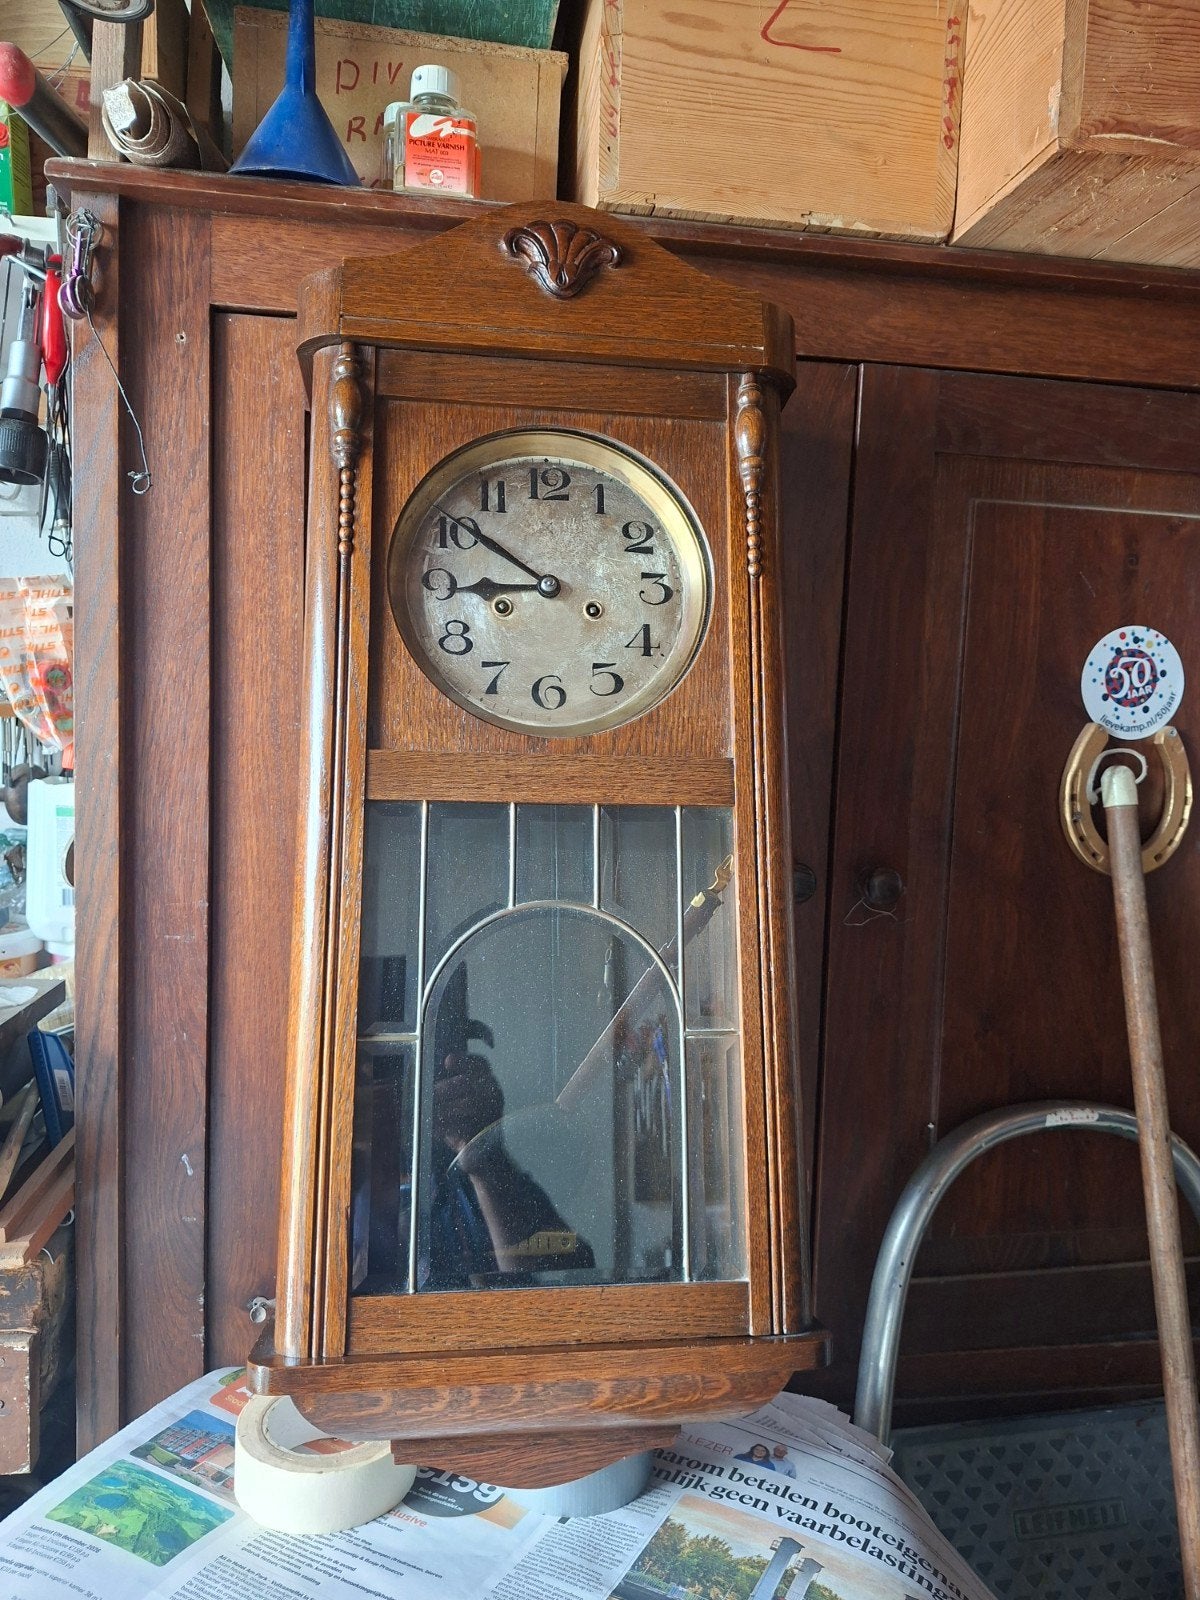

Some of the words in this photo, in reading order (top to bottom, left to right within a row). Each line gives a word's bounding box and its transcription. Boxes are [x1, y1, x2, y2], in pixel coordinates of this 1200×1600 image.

[409, 138, 435, 147] PICTURE
[437, 142, 465, 150] VARNISH
[480, 480, 506, 513] 11
[528, 467, 571, 501] 12
[590, 483, 606, 515] 1
[438, 515, 482, 550] 10
[621, 520, 654, 555] 2
[421, 567, 458, 601] 9
[639, 572, 674, 606] 3
[438, 619, 474, 656] 8
[624, 624, 661, 657] 4
[481, 660, 511, 695] 7
[531, 675, 567, 710] 6
[589, 662, 625, 696] 5
[1109, 656, 1152, 699] 50
[1127, 685, 1153, 699] JAAR
[687, 1434, 733, 1455] LEZER
[652, 1447, 725, 1477] aarom
[728, 1467, 817, 1512] betalen
[708, 1486, 770, 1513] geen
